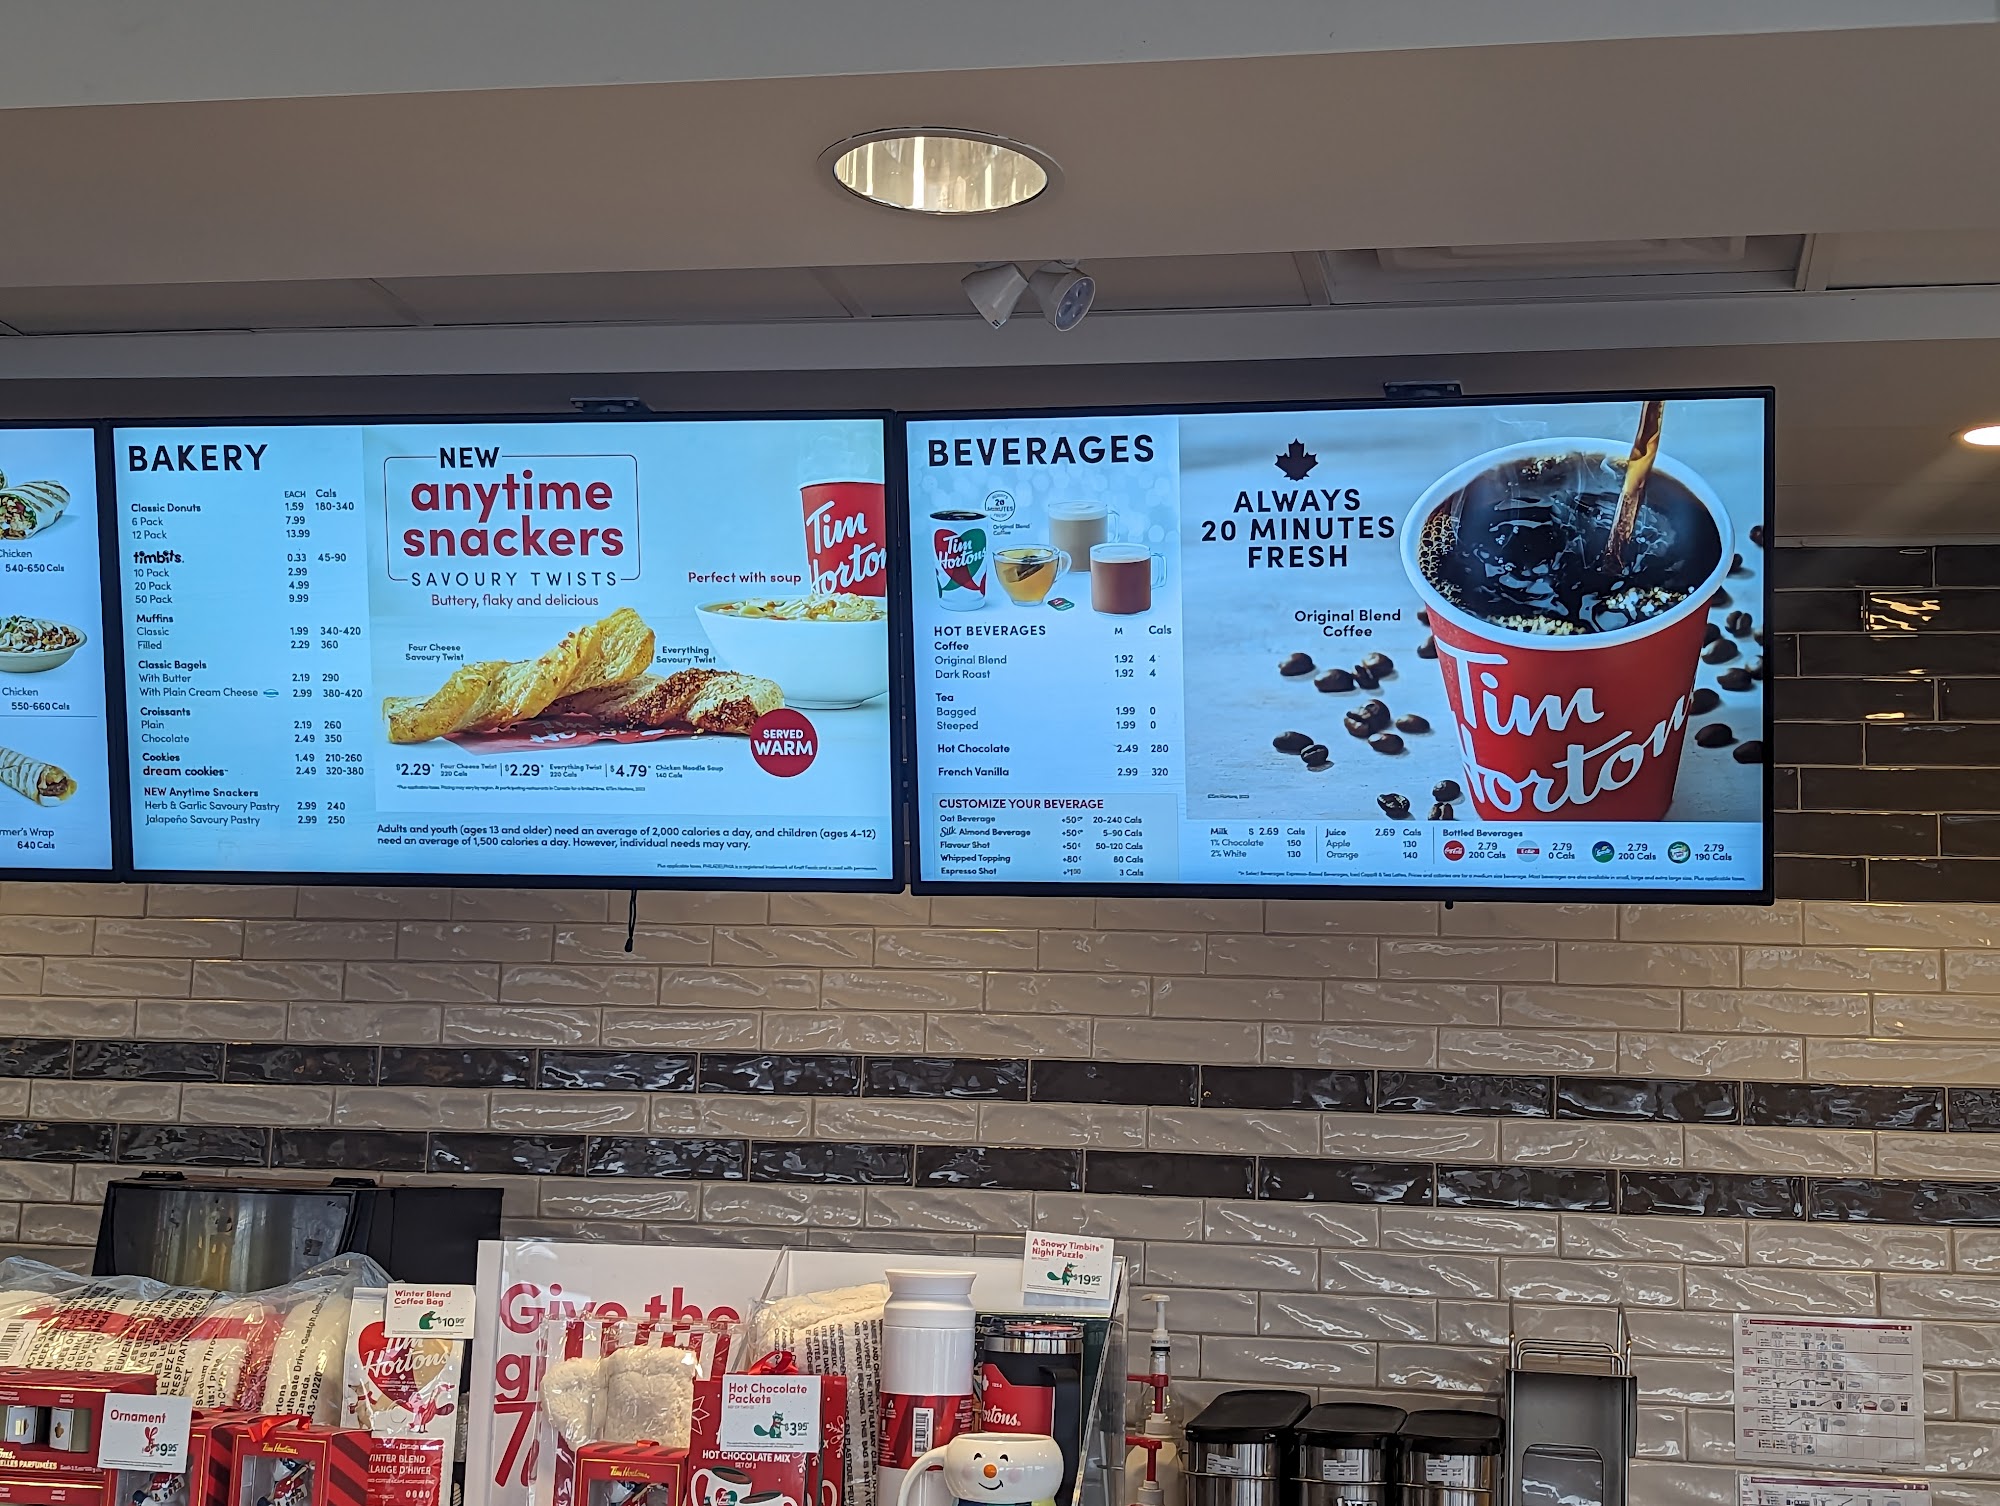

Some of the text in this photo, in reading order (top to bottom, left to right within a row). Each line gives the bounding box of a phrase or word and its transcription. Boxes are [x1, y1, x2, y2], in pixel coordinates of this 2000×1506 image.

[929, 435, 1153, 466] BEVERAGES
[129, 444, 267, 471] BAKERY
[440, 447, 499, 468] NEW
[316, 489, 336, 497] Cals
[412, 470, 612, 523] anytime
[1234, 489, 1360, 513] ALWAYS
[131, 502, 354, 512] Classic Donuts 1.59 180-340
[132, 516, 305, 526] 6 Pack 7.99
[806, 501, 868, 554] Tim
[1202, 516, 1394, 541] 20 MINUTES
[133, 531, 141, 539] 12
[144, 530, 167, 539] Pack
[404, 515, 623, 556] snackers
[943, 534, 972, 553] Tim
[288, 554, 306, 562] 0.33
[318, 553, 346, 561] 45-90
[1249, 545, 1347, 568] FRESH
[6, 564, 45, 572] 540-650
[134, 568, 307, 577] 10 Pack 2.99
[412, 572, 615, 586] SAVOURY TWISTS
[689, 572, 801, 585] Perfect with soup
[432, 594, 598, 609] Buttery, flaky and delicious
[137, 614, 173, 622] Muffins
[1295, 609, 1400, 625] Original Blend
[935, 625, 1171, 636] HOT BEVERAGES Cals
[1323, 625, 1372, 636] Coffee
[430, 643, 460, 651] Cheese
[935, 641, 968, 650] Coffee
[663, 646, 709, 658] Everything
[406, 653, 440, 662] Savoury
[657, 654, 715, 665] Savoury Twist
[935, 655, 1133, 666] Original Blend 1.92
[936, 669, 1133, 678] Dark Roast 1.92
[2, 687, 38, 696] Chicken
[1436, 638, 1604, 737] Tim
[936, 693, 953, 701] Tea
[12, 702, 50, 710] 550-660
[140, 707, 190, 716] Croissants
[937, 707, 1135, 718] Bagged 1.99
[141, 720, 341, 729] Plain 2.19 260
[937, 721, 1135, 732] Steeped 1.99
[142, 734, 189, 742] Chocolate
[295, 734, 315, 742] 2.49
[764, 730, 803, 738] SERVED
[754, 740, 813, 755] WARM
[938, 744, 955, 752] Hot
[958, 744, 1010, 752] Chocolate
[142, 753, 180, 761] Cookies
[939, 767, 1168, 776] French Vanilla 2.99 320
[170, 787, 258, 798] Anytime Snackers
[939, 799, 1103, 808] CUSTOMIZE YOUR BEVERAGE
[958, 815, 995, 824] Beverage
[30, 828, 54, 839] Wrap
[1326, 829, 1346, 838] Juice
[1477, 830, 1522, 839] Beverages
[18, 841, 55, 849] 640 Cals
[378, 836, 401, 844] need
[419, 839, 459, 847] average
[462, 836, 471, 845] of
[474, 837, 498, 846] 1,500
[501, 837, 538, 846] calories
[550, 837, 571, 850] day.
[573, 838, 617, 848] However,
[620, 838, 668, 849] individual
[671, 838, 701, 849] needs
[702, 842, 724, 852] may
[726, 842, 751, 852] vary.
[1326, 840, 1350, 849] Apple
[1327, 851, 1358, 860] Orange
[941, 867, 976, 876] Espresso
[1041, 1239, 1067, 1250] Snowy
[1032, 1247, 1054, 1257] Night
[1057, 1250, 1083, 1259] Puzzle
[427, 1298, 443, 1307] Bag
[364, 1348, 449, 1377] Hortons
[730, 1383, 807, 1393] Hot Chocolate
[729, 1393, 770, 1403] Packets
[110, 1410, 166, 1423] Ornament
[399, 1455, 426, 1463] BLEND
[702, 1450, 790, 1463] HOT CHOCOLATE MIX
[19, 1458, 57, 1470] PARFUMÉES
[400, 1466, 431, 1475] D'HIVER
